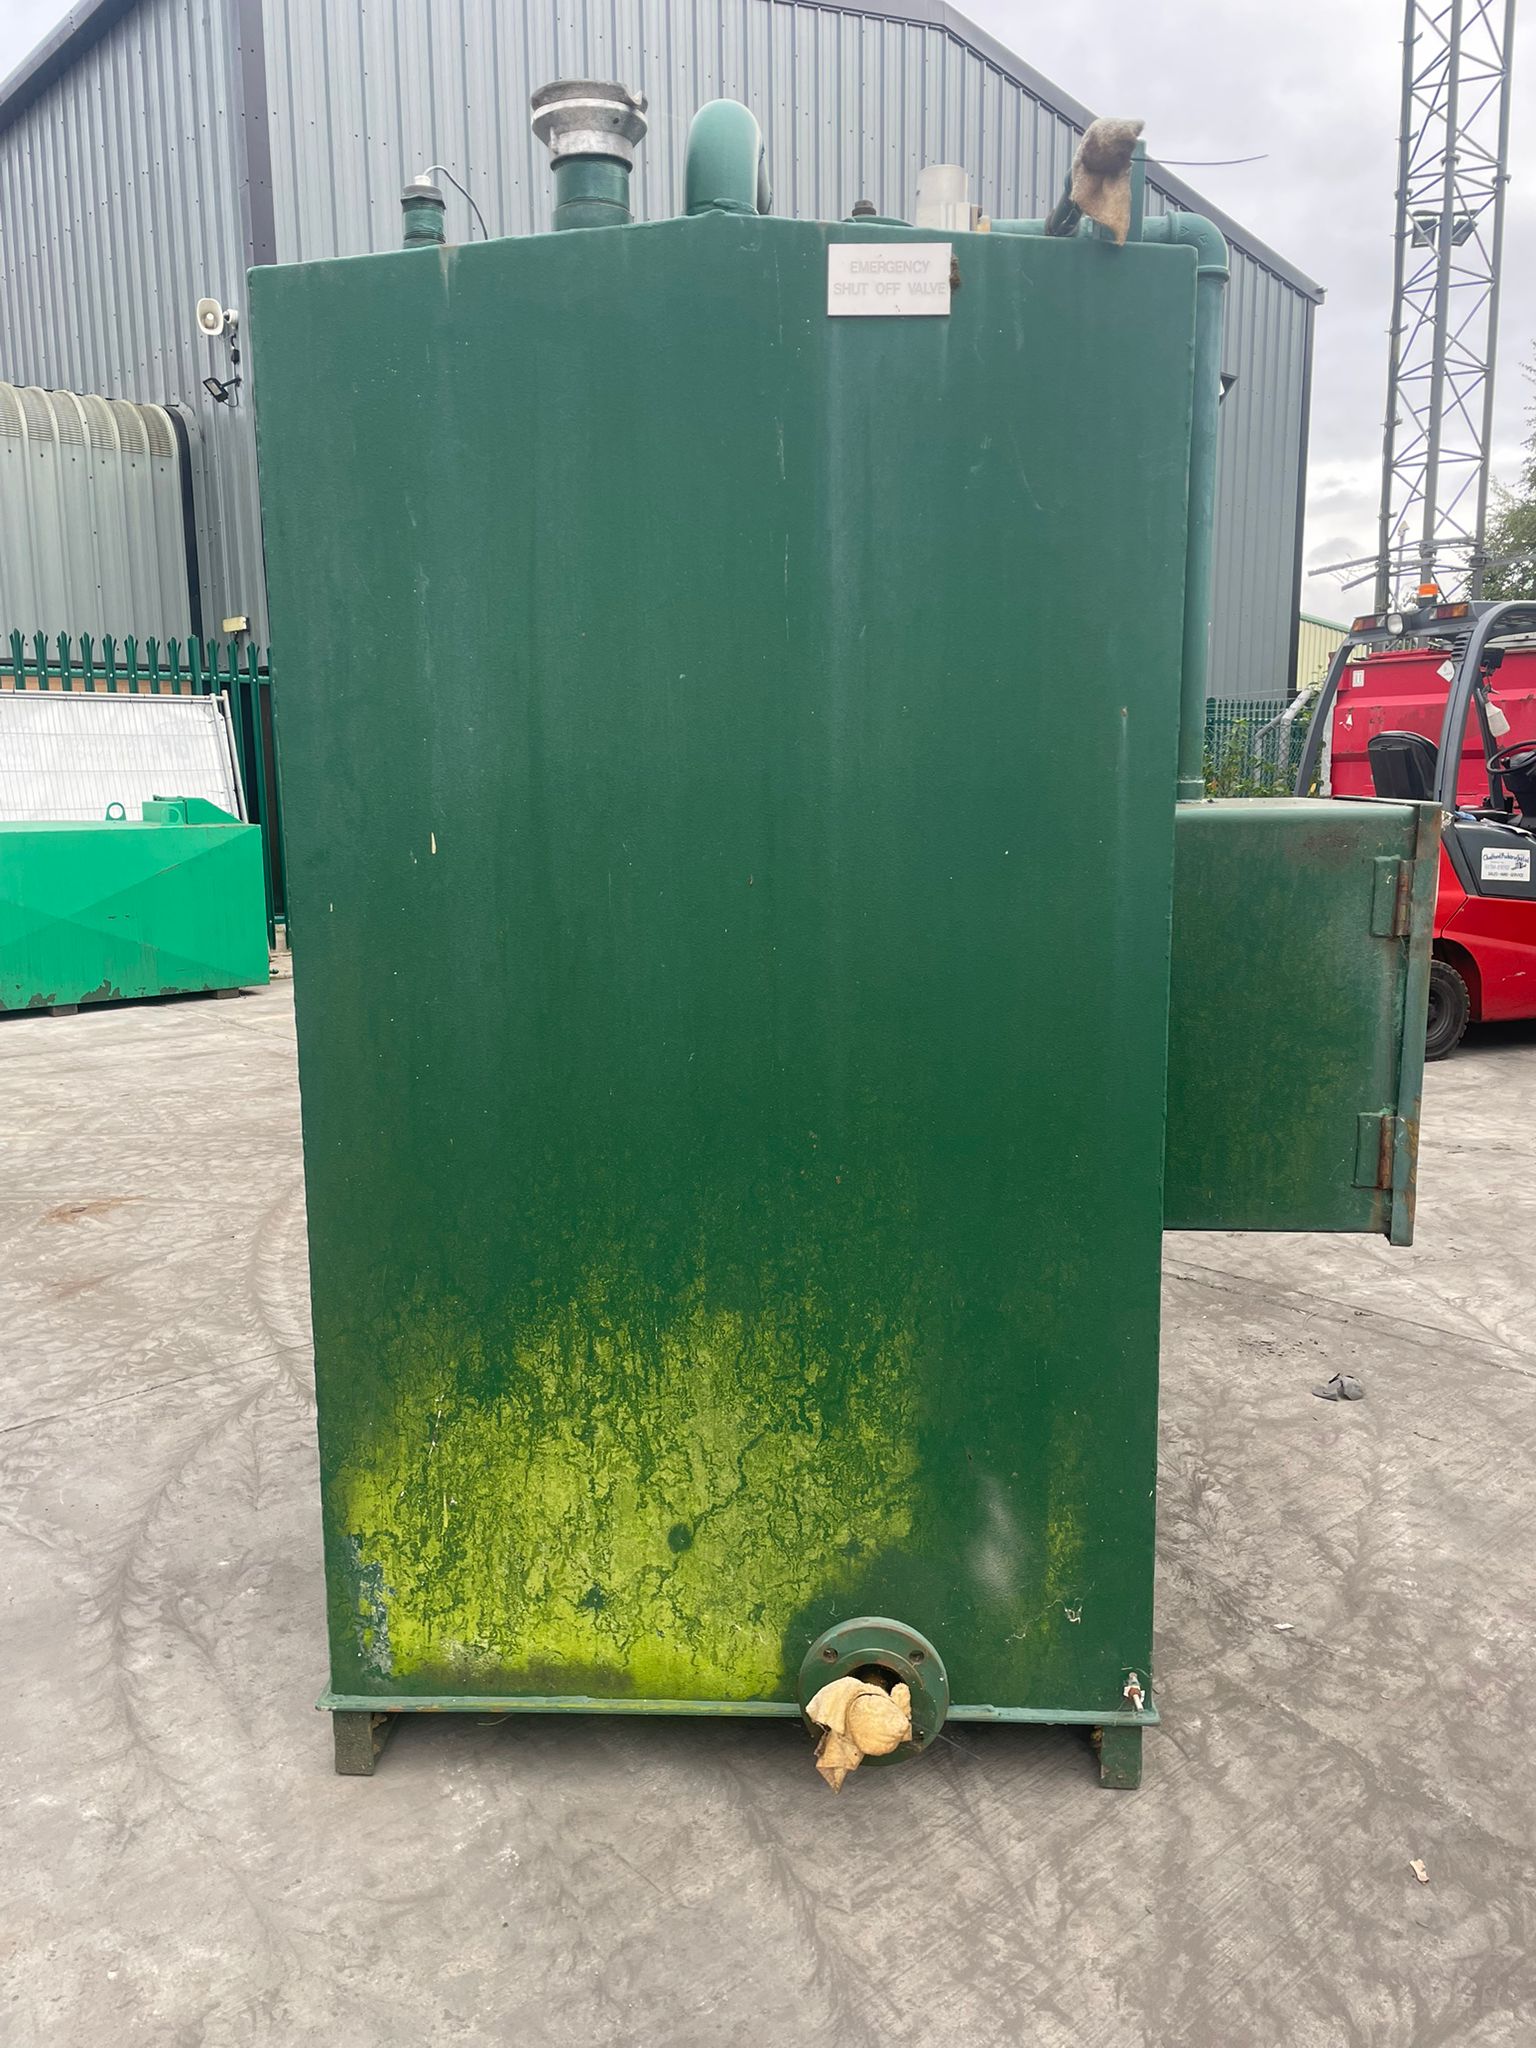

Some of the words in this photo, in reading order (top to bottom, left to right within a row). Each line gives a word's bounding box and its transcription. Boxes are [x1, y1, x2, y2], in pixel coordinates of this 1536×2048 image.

[850, 260, 931, 274] EMERGENCY
[833, 282, 869, 295] SHUT
[875, 282, 901, 295] OFF
[907, 282, 946, 295] VALVE
